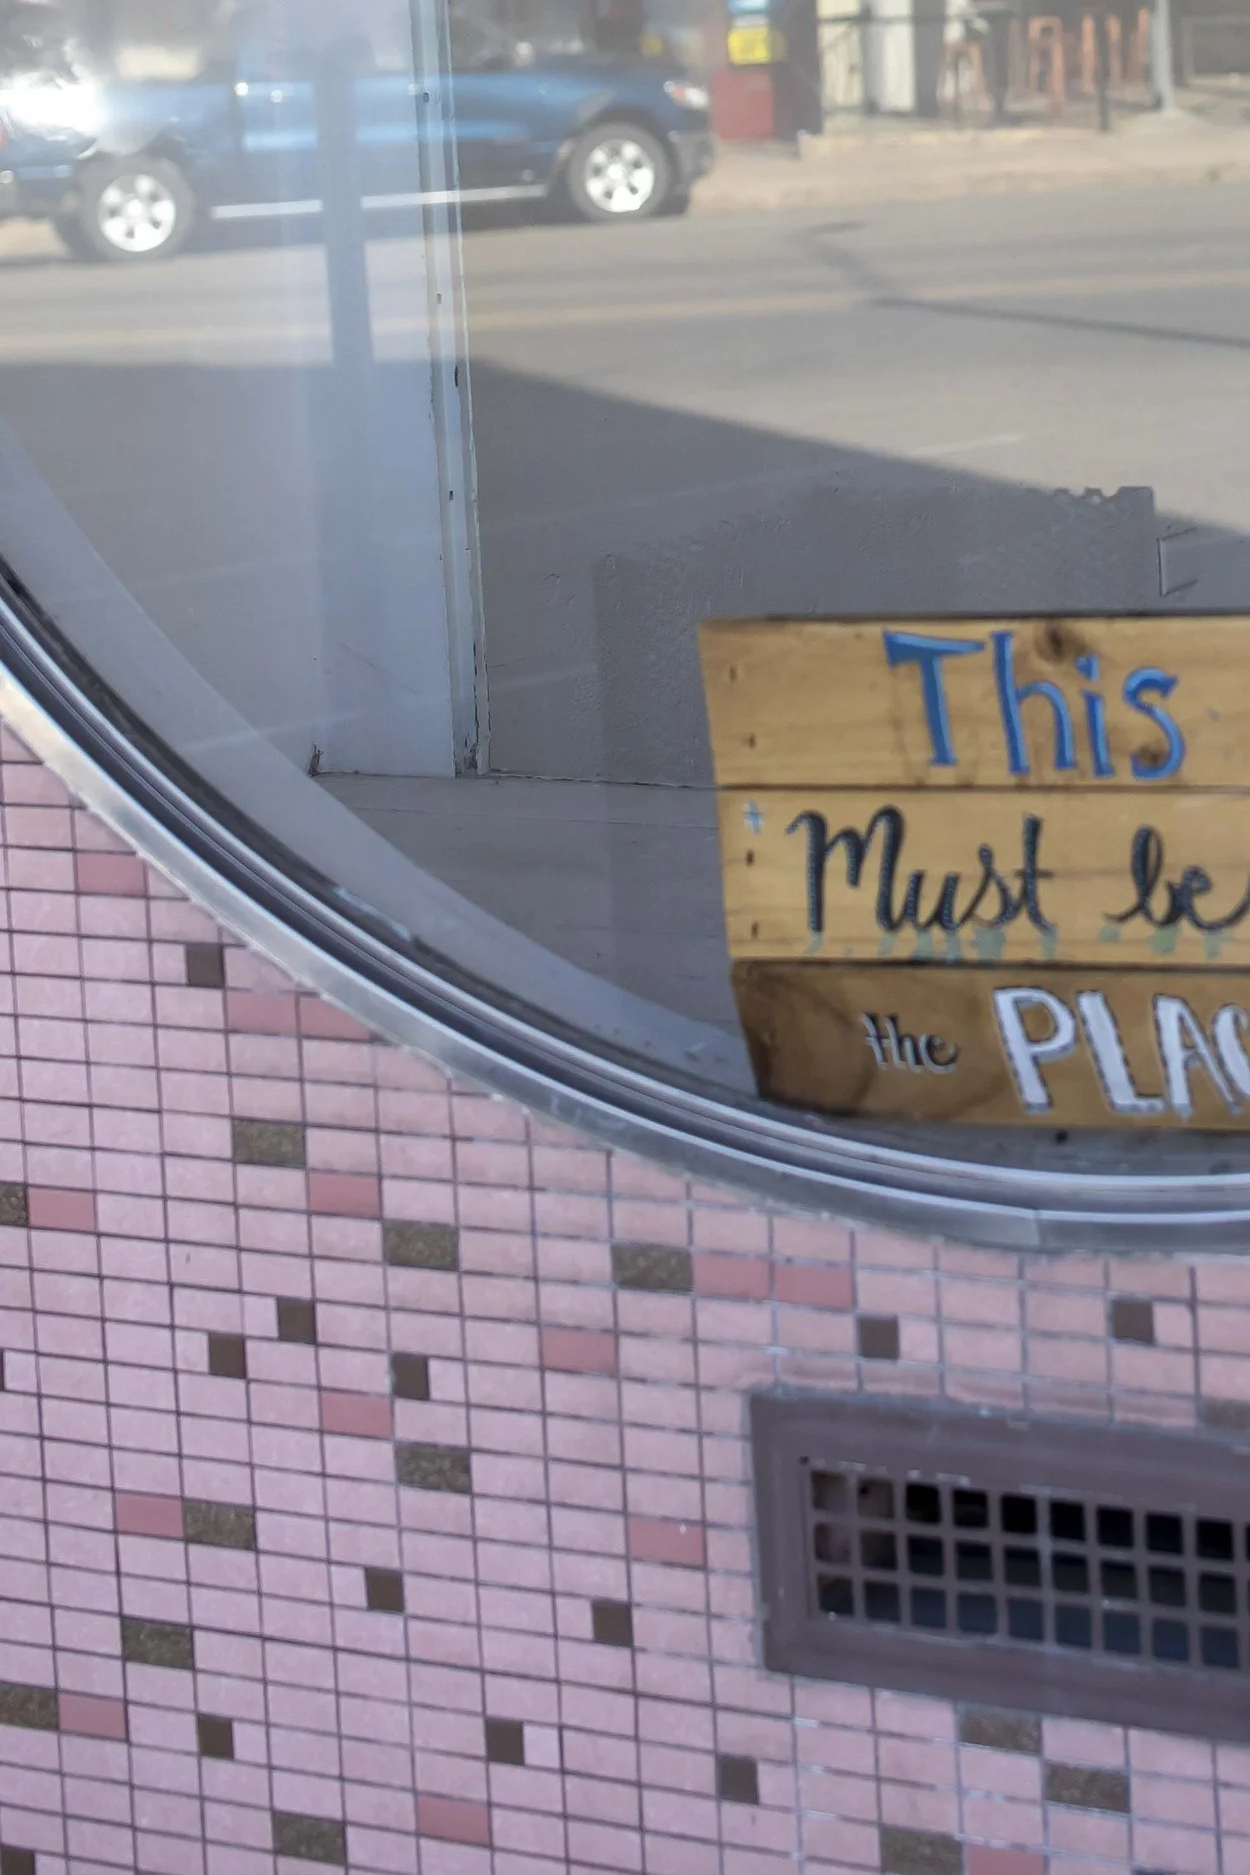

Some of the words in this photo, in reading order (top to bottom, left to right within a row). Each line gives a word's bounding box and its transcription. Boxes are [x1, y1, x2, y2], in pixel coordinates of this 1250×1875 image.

[882, 627, 1186, 780] This
[786, 804, 1055, 935] Must
[861, 1011, 959, 1074] the
